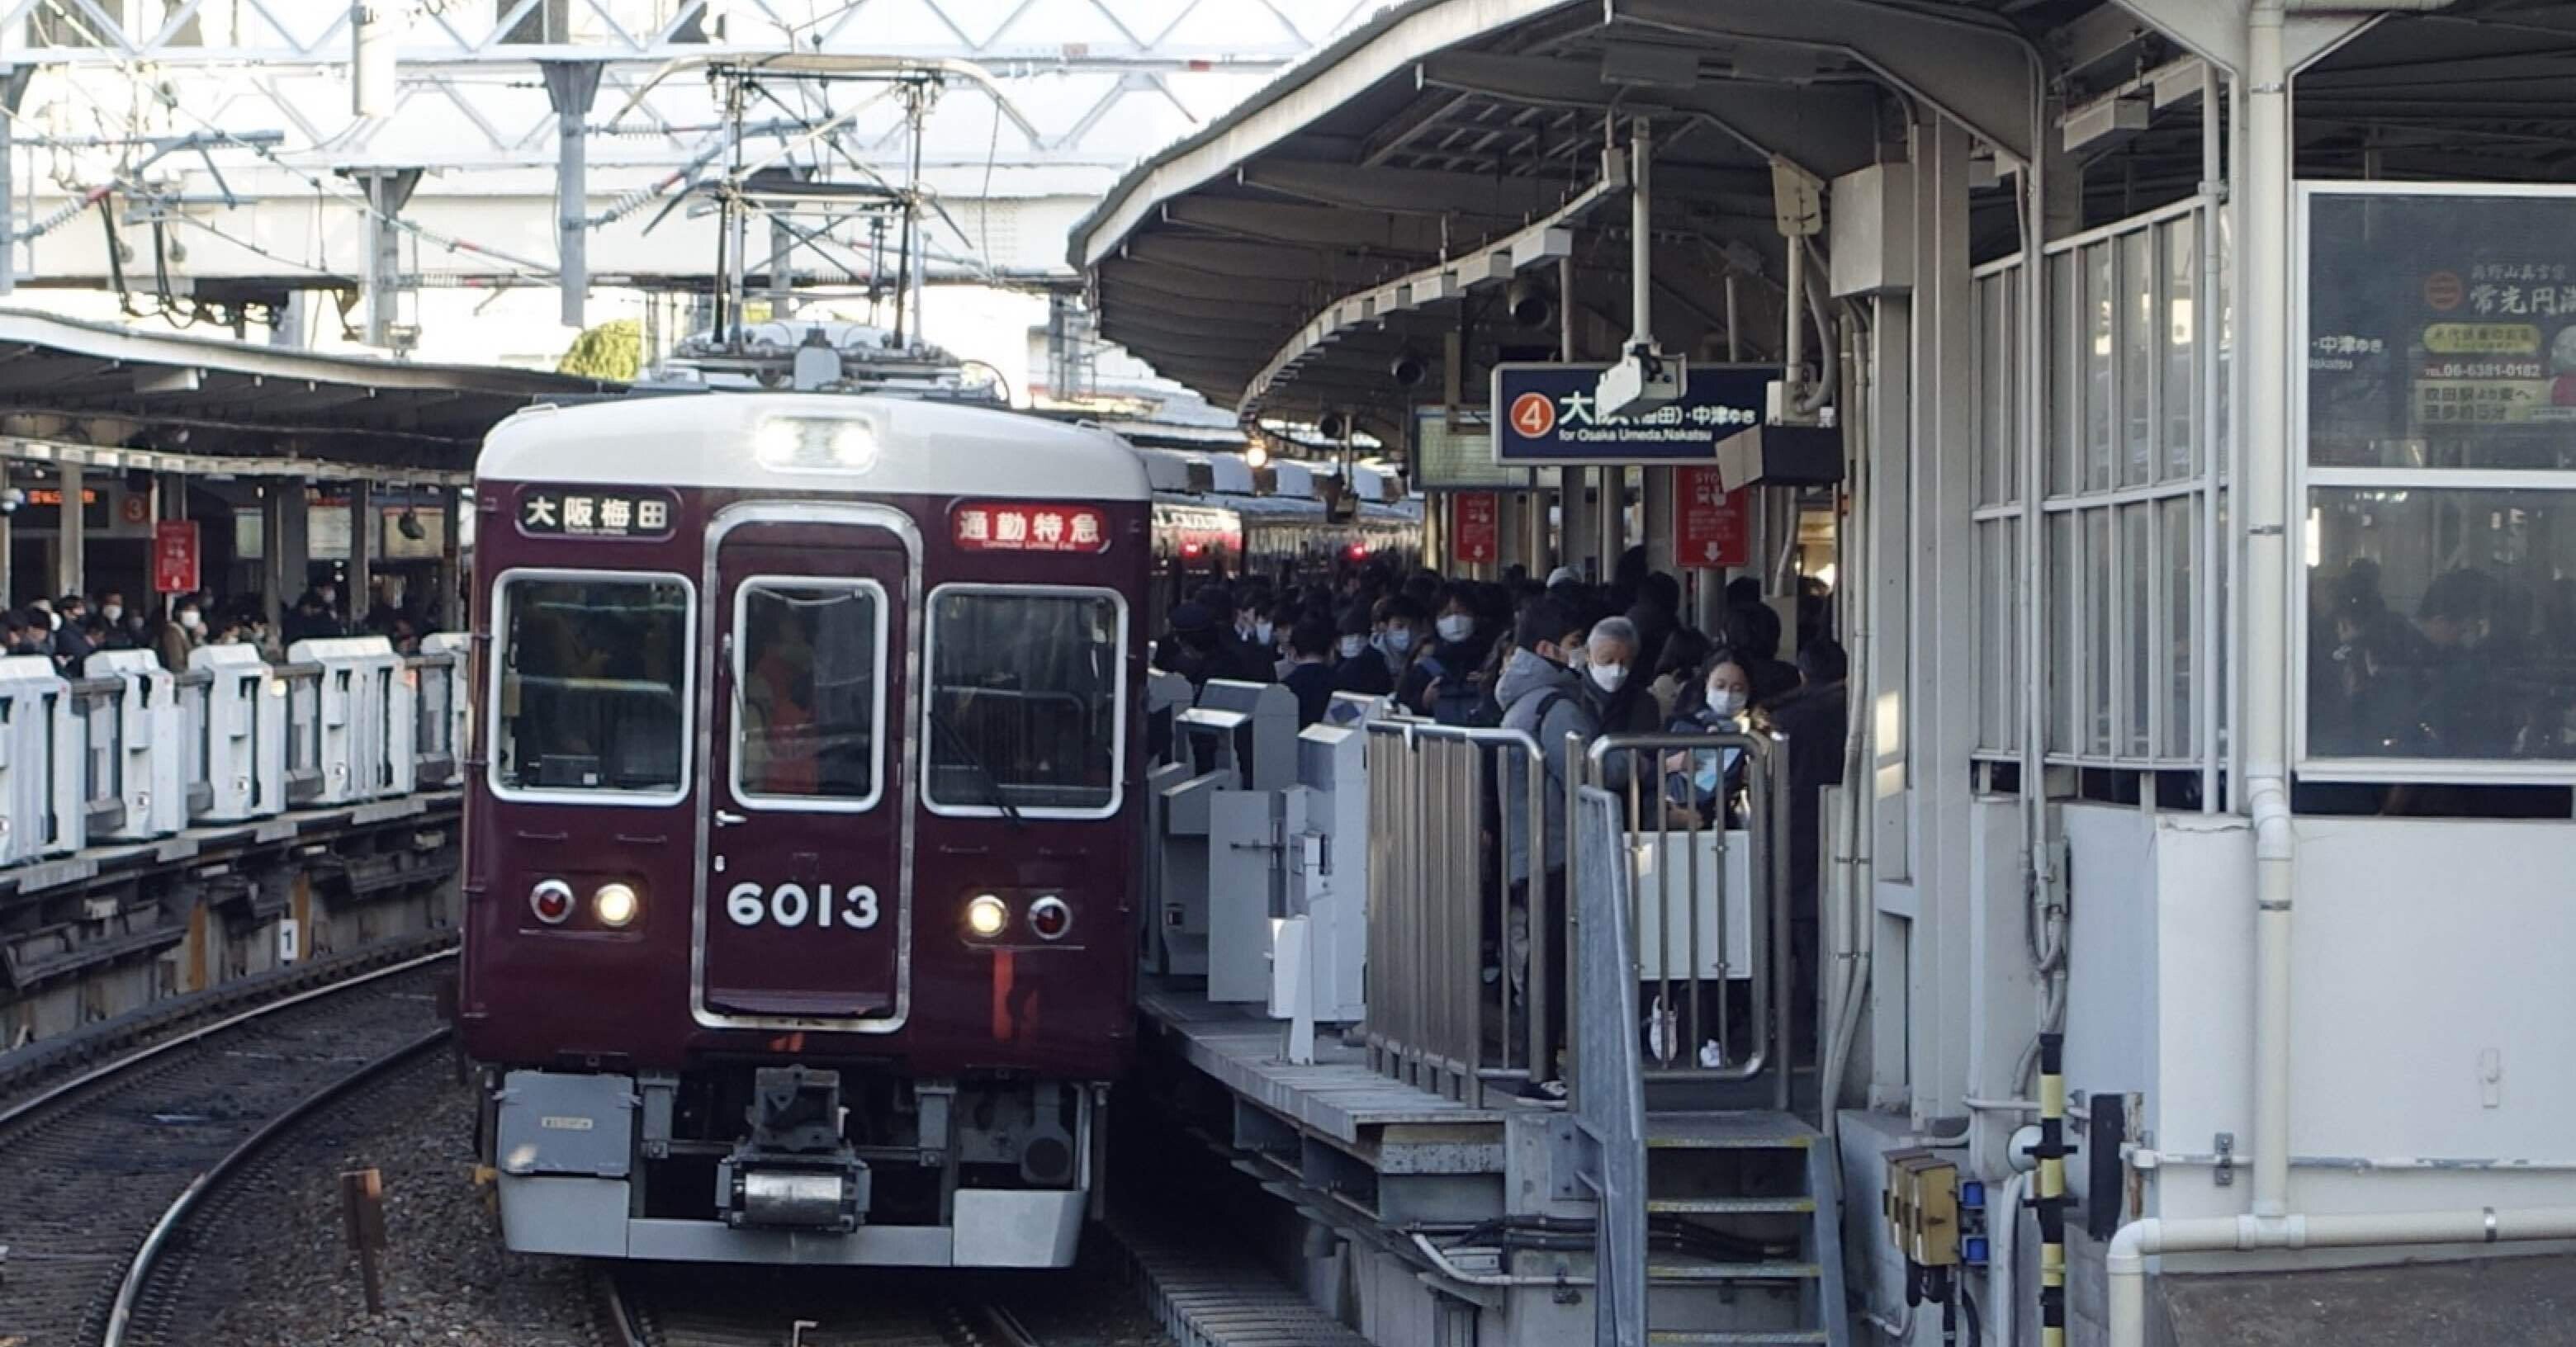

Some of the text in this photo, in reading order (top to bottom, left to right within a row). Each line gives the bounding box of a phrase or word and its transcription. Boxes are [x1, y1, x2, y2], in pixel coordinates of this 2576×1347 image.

[1520, 399, 1543, 431] 4
[1558, 390, 1756, 425] 大田)・中津ゆき
[1558, 429, 1574, 441] for
[1578, 429, 1616, 442] Osaka
[129, 499, 144, 521] 3
[525, 495, 667, 528] 大阪梅田
[959, 510, 1100, 542] 通勤特急
[727, 881, 879, 928] 6013
[282, 929, 292, 952] 1
